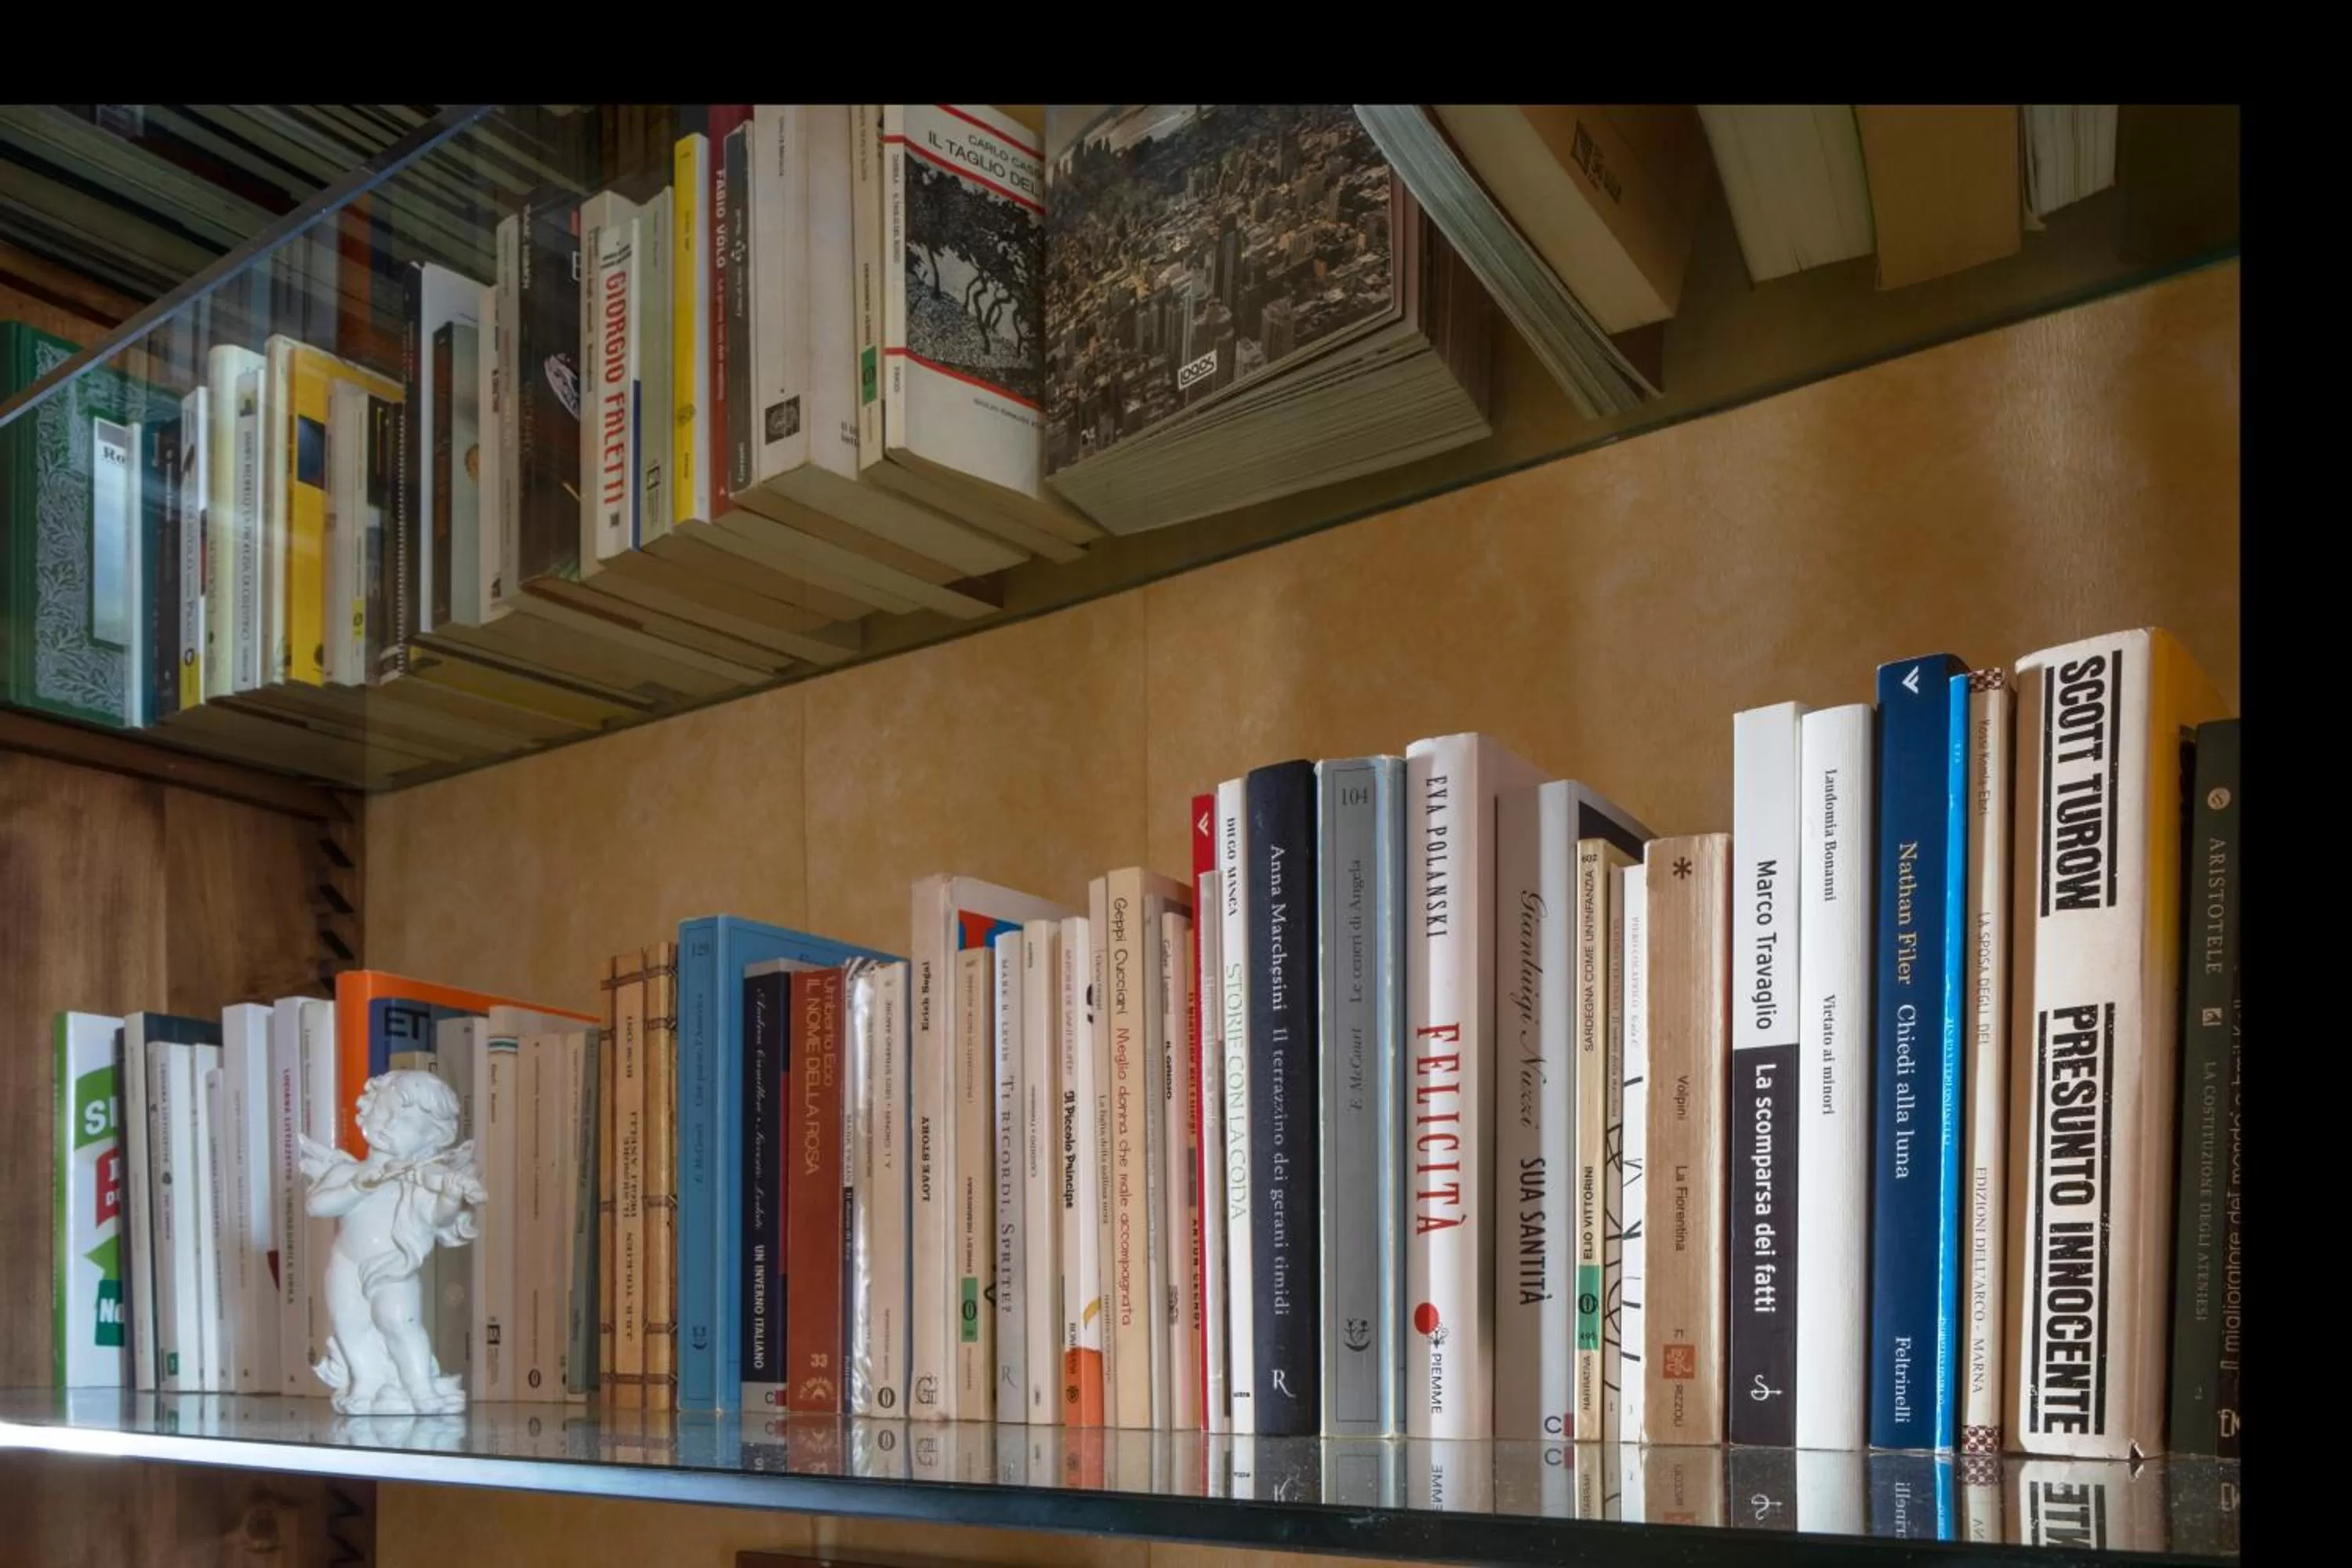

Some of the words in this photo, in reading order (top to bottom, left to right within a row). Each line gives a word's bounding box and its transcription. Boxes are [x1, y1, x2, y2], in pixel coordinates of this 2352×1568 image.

[928, 129, 943, 150] IL
[946, 139, 1006, 179] TAGLIO
[968, 134, 1009, 162] CARLO
[716, 169, 726, 218] FABIO
[716, 224, 726, 269] VOLO
[604, 270, 627, 384] GIORGIO
[604, 391, 626, 506] FALETTI
[2057, 655, 2107, 762] SCOTT
[1426, 776, 1447, 816] EVA
[1824, 768, 1838, 837] Laudomia
[1227, 817, 1237, 860] DIEGO
[2055, 772, 2103, 912] TUROW
[1270, 844, 1286, 898] Anna
[1425, 826, 1449, 939] POLANSKI
[1755, 859, 1777, 926] Marco
[1823, 840, 1837, 902] Bonanni
[1897, 841, 1918, 925] Nathan
[1110, 897, 1128, 942] Geppi
[1977, 911, 1992, 927] LA
[2205, 837, 2227, 976] ARISTOTELE
[1269, 903, 1289, 1011] Marchesini
[1510, 890, 1549, 1026] Gianluigi
[1584, 946, 1595, 982] COME
[1897, 932, 1917, 985] Filer
[1977, 932, 1991, 973] SPOSA
[805, 978, 820, 993] IL
[1113, 948, 1129, 1016] Cucciari
[1225, 963, 1243, 1048] STORIE
[1751, 931, 1777, 1030] Travaglio
[805, 997, 821, 1054] NOME
[822, 975, 837, 1050] Umberto
[1272, 1028, 1289, 1042] Il
[1584, 986, 1595, 1051] SARDEGNA
[1822, 993, 1836, 1045] Vietato
[1113, 1027, 1131, 1080] Meglio
[1821, 1047, 1836, 1062] ai
[1896, 1004, 1916, 1077] Chiedi
[805, 1058, 820, 1117] DELLA
[822, 1053, 836, 1087] Eco
[1227, 1055, 1245, 1109] CON
[1519, 1029, 1548, 1130] Nuzzi
[1755, 1063, 1777, 1090] La
[1821, 1065, 1836, 1116] minori
[2204, 1060, 2217, 1080] LA
[1116, 1085, 1133, 1134] donna
[1272, 1049, 1287, 1146] terrazzino
[1671, 1075, 1690, 1121] Volpini
[1895, 1083, 1915, 1123] alla
[2049, 1004, 2099, 1207] PRESUNTO
[804, 1120, 819, 1175] ROSA
[921, 1116, 931, 1162] STORY
[1064, 1105, 1075, 1152] Piccolo
[1118, 1140, 1134, 1167] che
[1229, 1116, 1246, 1147] LA
[1416, 1022, 1468, 1236] FELICITÀ
[1894, 1131, 1915, 1179] luna
[2198, 1084, 2217, 1197] COSTITUZIONE
[1063, 1153, 1076, 1209] Principe
[1229, 1145, 1247, 1221] CODA
[1273, 1152, 1289, 1181] dei
[1519, 1157, 1546, 1203] SUA
[1675, 1165, 1688, 1182] La
[1750, 1096, 1774, 1216] scomparsa
[921, 1167, 931, 1203] LOVE
[1119, 1174, 1134, 1207] male
[1584, 1165, 1594, 1228] VITTORINI
[1974, 1167, 1988, 1233] EDIZIONI
[1269, 1189, 1290, 1249] gerani
[1583, 1232, 1594, 1259] ELIO
[1674, 1186, 1690, 1251] Fiorentina
[1755, 1222, 1776, 1256] dei
[2197, 1202, 2213, 1247] DEGLI
[753, 1244, 765, 1262] UN
[1116, 1213, 1134, 1327] accompagnata
[1519, 1210, 1554, 1305] SANTITÀ
[1973, 1236, 1988, 1323] DELL'ARCO
[754, 1265, 766, 1314] INVERNO
[1273, 1256, 1290, 1316] timidi
[1754, 1263, 1777, 1313] fatti
[2194, 1252, 2210, 1320] ATENIESI
[754, 1317, 766, 1369] ITALIANO
[2043, 1221, 2095, 1435] INNOCENTE
[1430, 1352, 1444, 1415] PIEMME
[1893, 1336, 1912, 1425] Feltrinelli
[1971, 1338, 1985, 1395] MARNA
[1673, 1384, 1684, 1428] RIZZOLI
